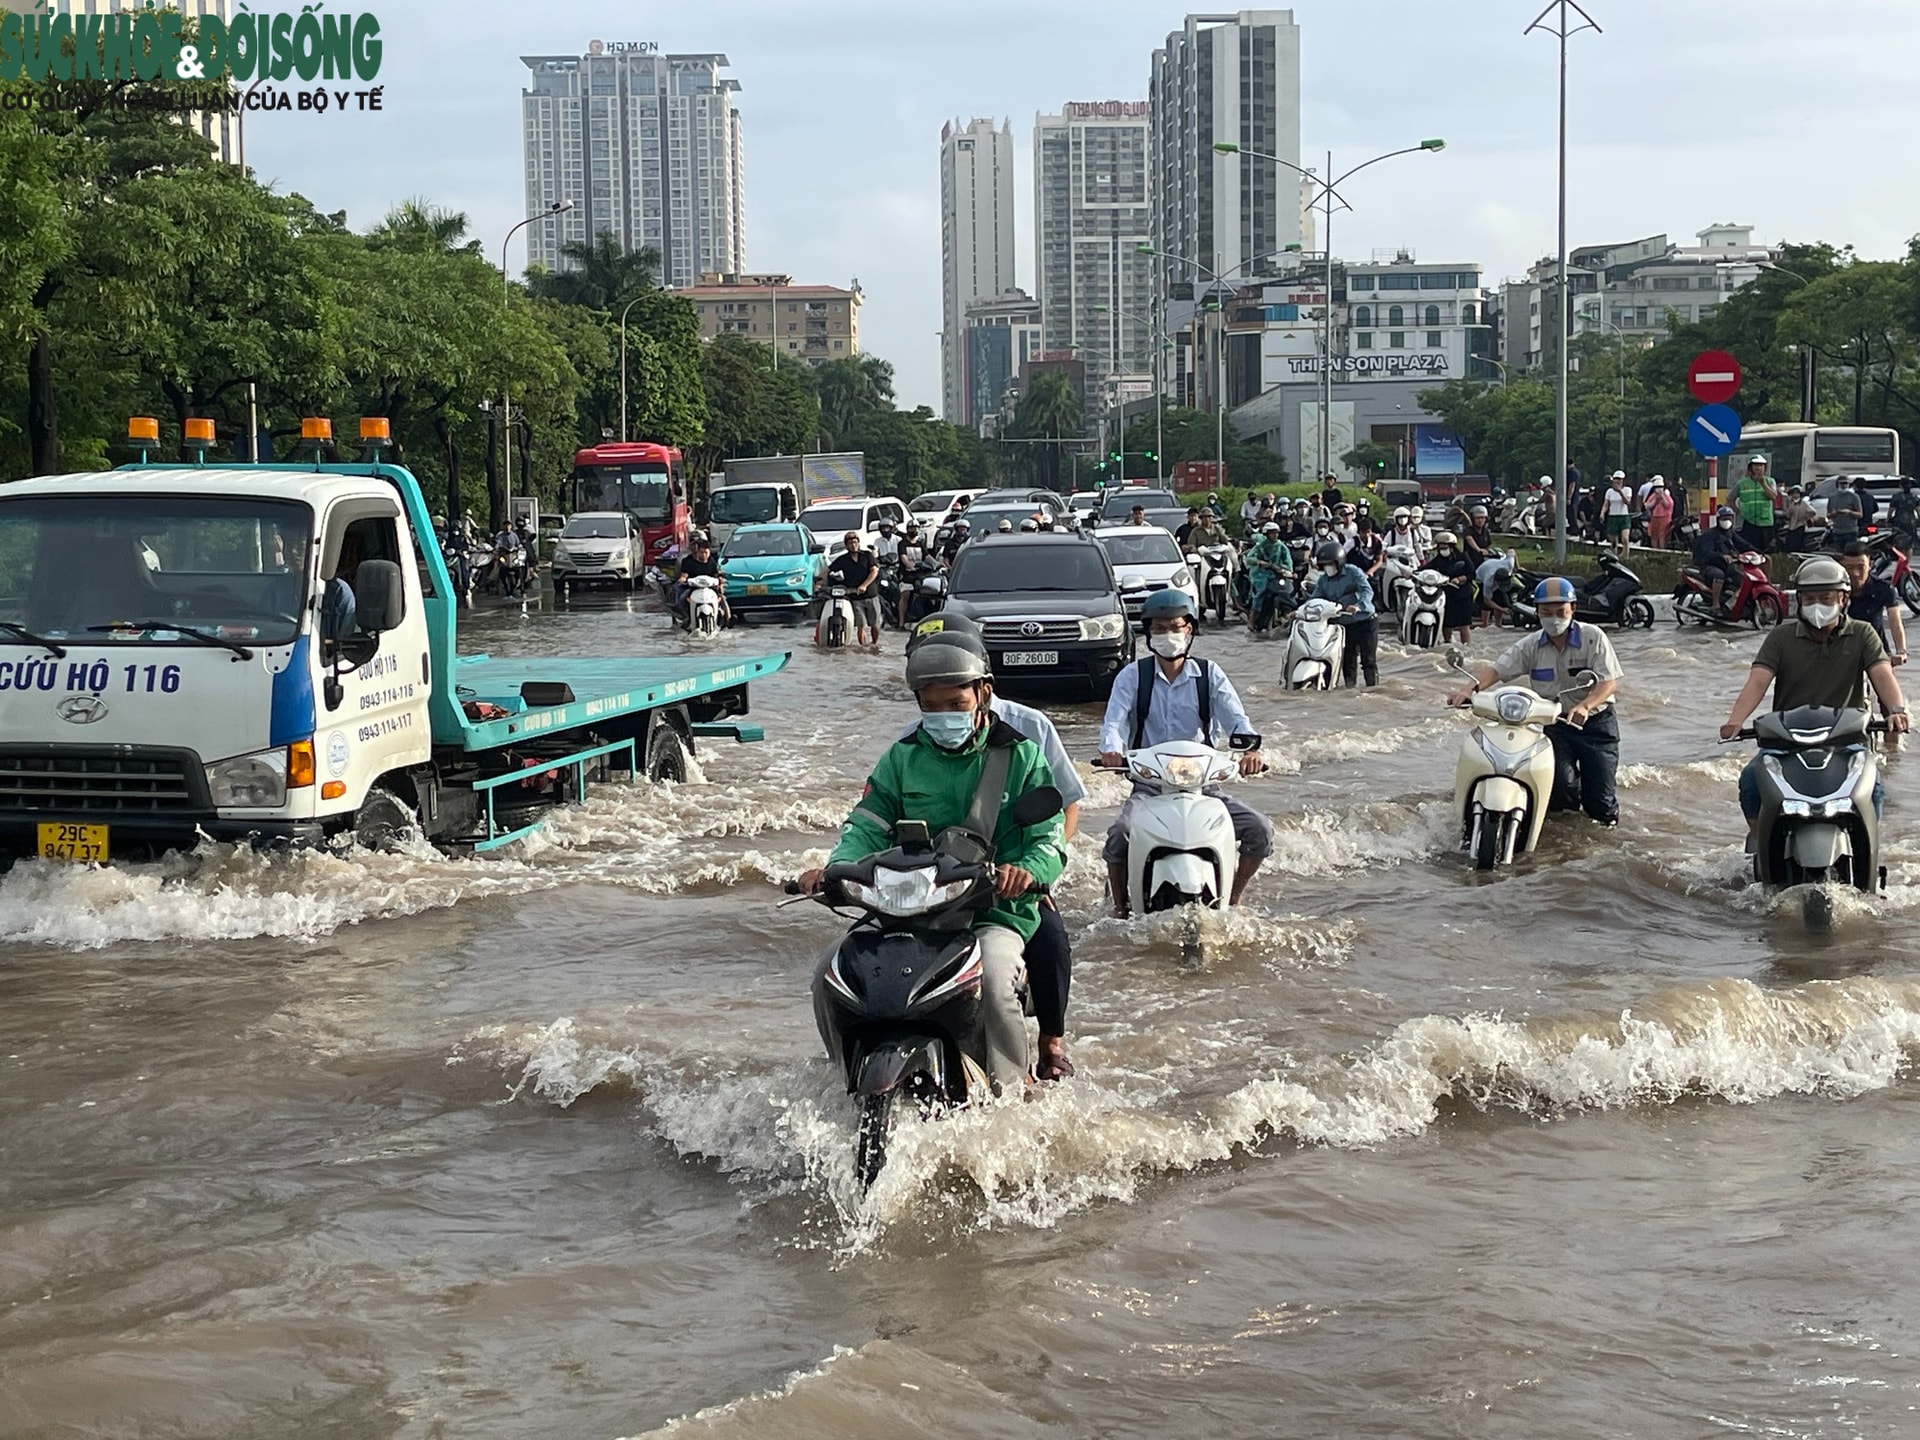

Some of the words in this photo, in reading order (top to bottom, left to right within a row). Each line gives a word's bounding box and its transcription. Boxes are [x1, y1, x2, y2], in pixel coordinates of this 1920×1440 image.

[1344, 355, 1383, 372] SON
[1385, 354, 1448, 371] PLAZA
[0, 655, 58, 691] CỨU
[66, 658, 109, 697] HỘ
[124, 665, 181, 693] 116
[58, 825, 88, 842] 29C
